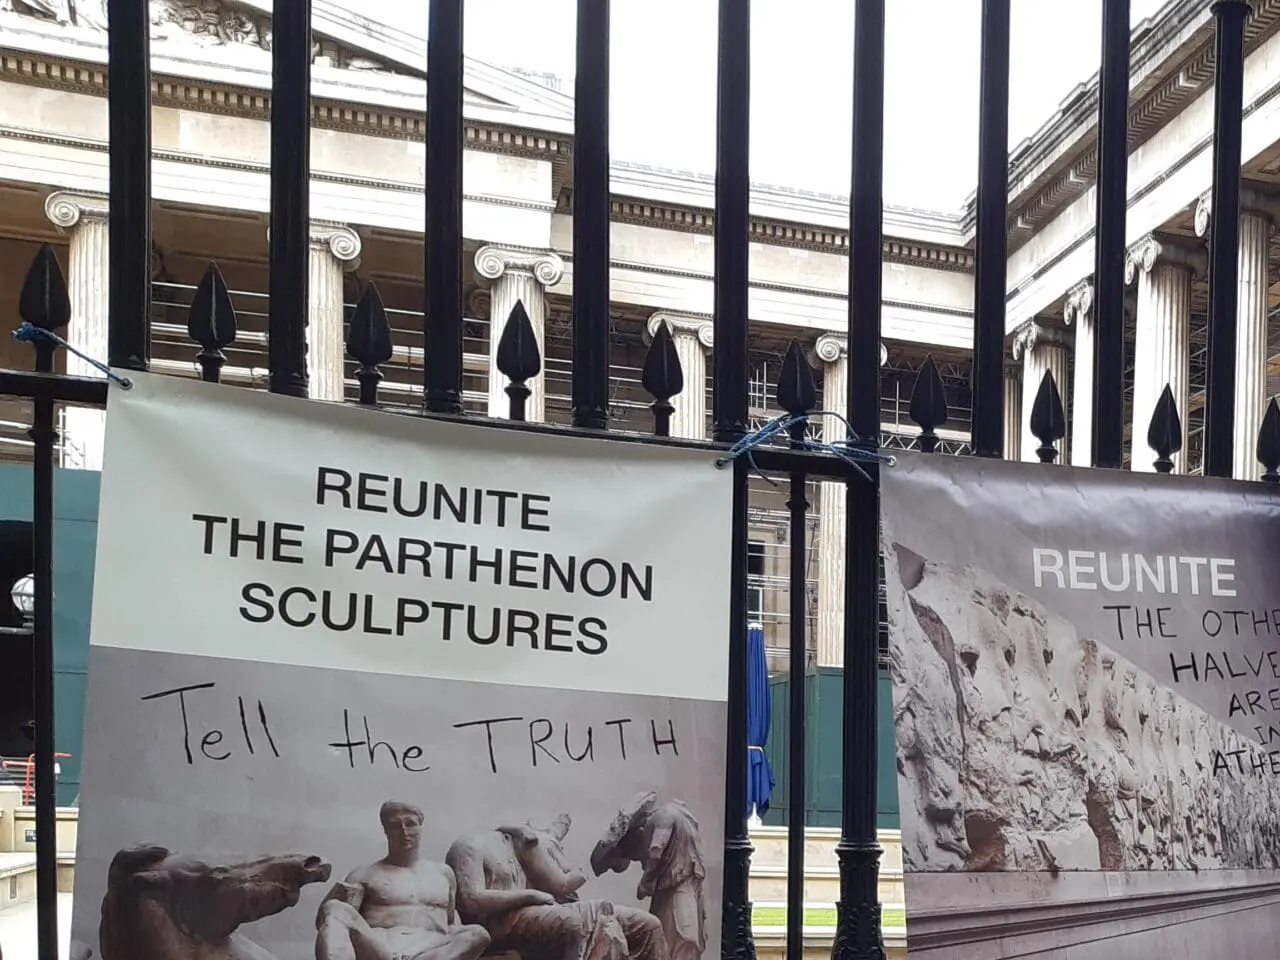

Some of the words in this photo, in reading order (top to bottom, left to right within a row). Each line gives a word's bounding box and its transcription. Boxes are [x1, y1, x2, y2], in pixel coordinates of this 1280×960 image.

[315, 466, 551, 532] REUNITE
[193, 514, 305, 565] THE
[325, 528, 652, 601] PARTHENON
[1032, 547, 1237, 597] REUNITE
[239, 582, 609, 656] SCULPTURES
[1103, 605, 1177, 641] THE
[141, 682, 279, 766] Tell
[328, 709, 430, 773] the
[453, 716, 680, 773] TRUTH
